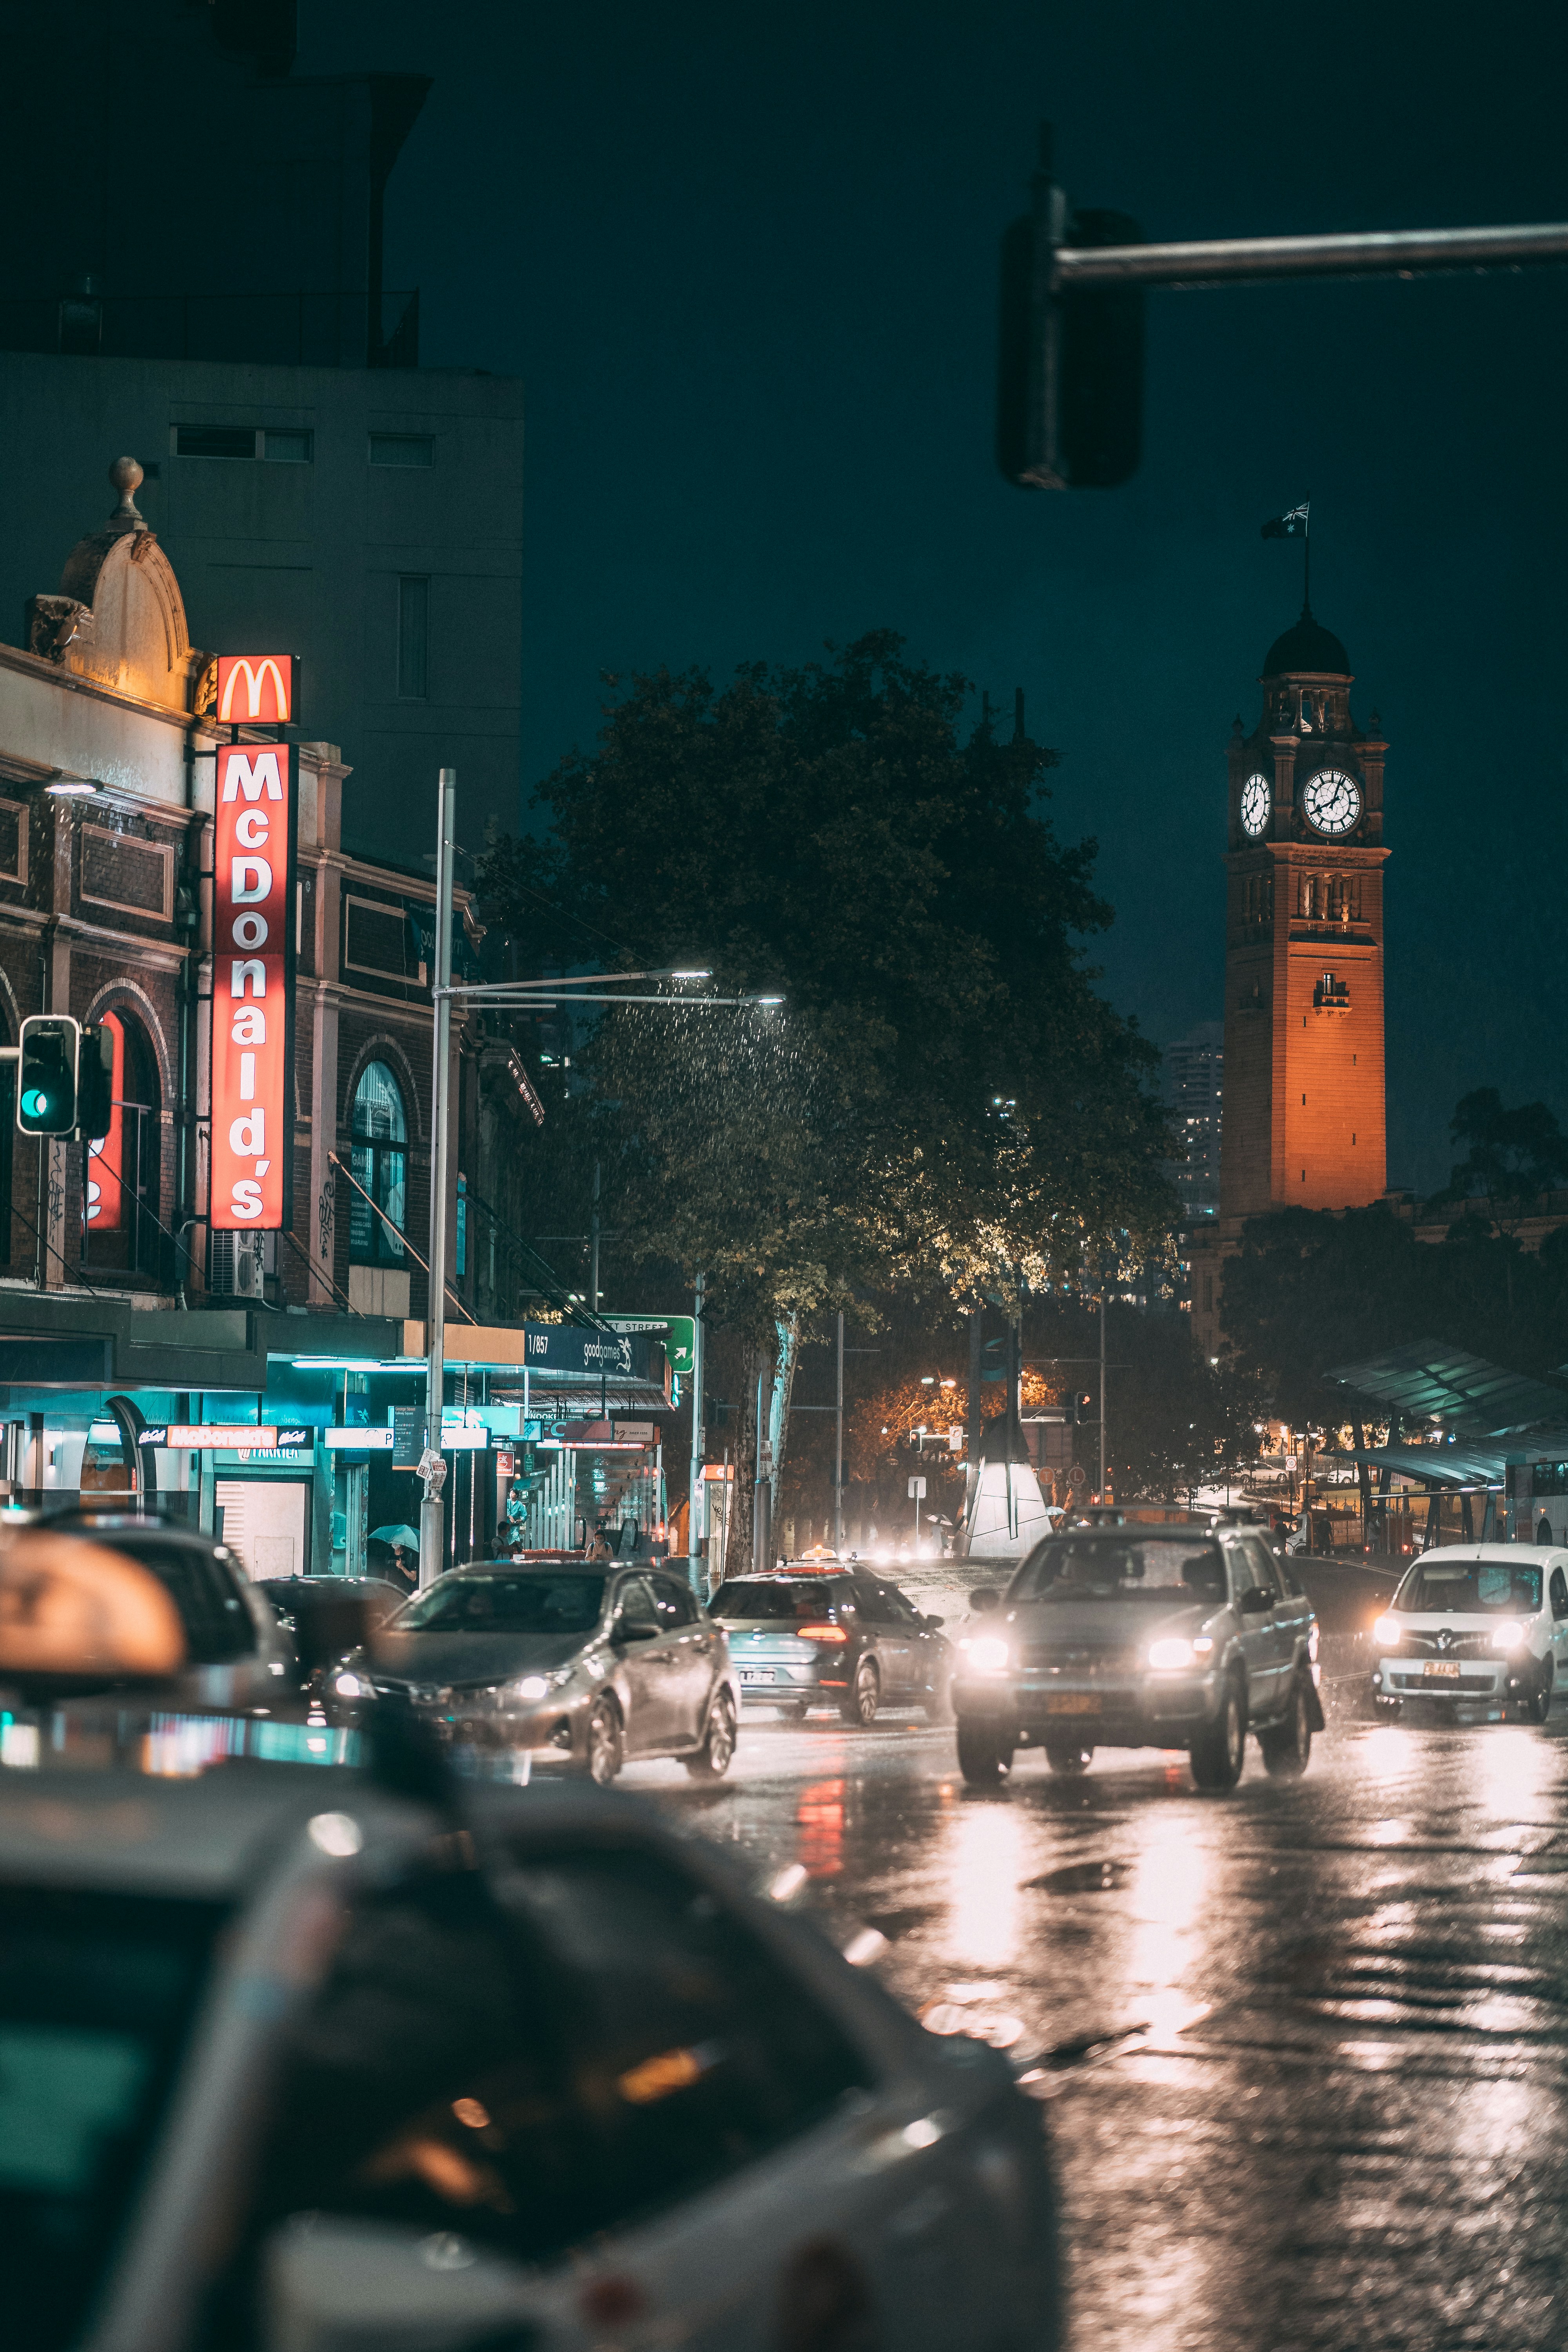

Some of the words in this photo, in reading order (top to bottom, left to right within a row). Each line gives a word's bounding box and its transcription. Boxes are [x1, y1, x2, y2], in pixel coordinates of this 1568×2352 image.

[221, 753, 283, 1220] McDonald's
[529, 1334, 548, 1354] 1/857
[584, 1335, 620, 1367] goodgames
[1074, 1471, 1080, 1481] L
